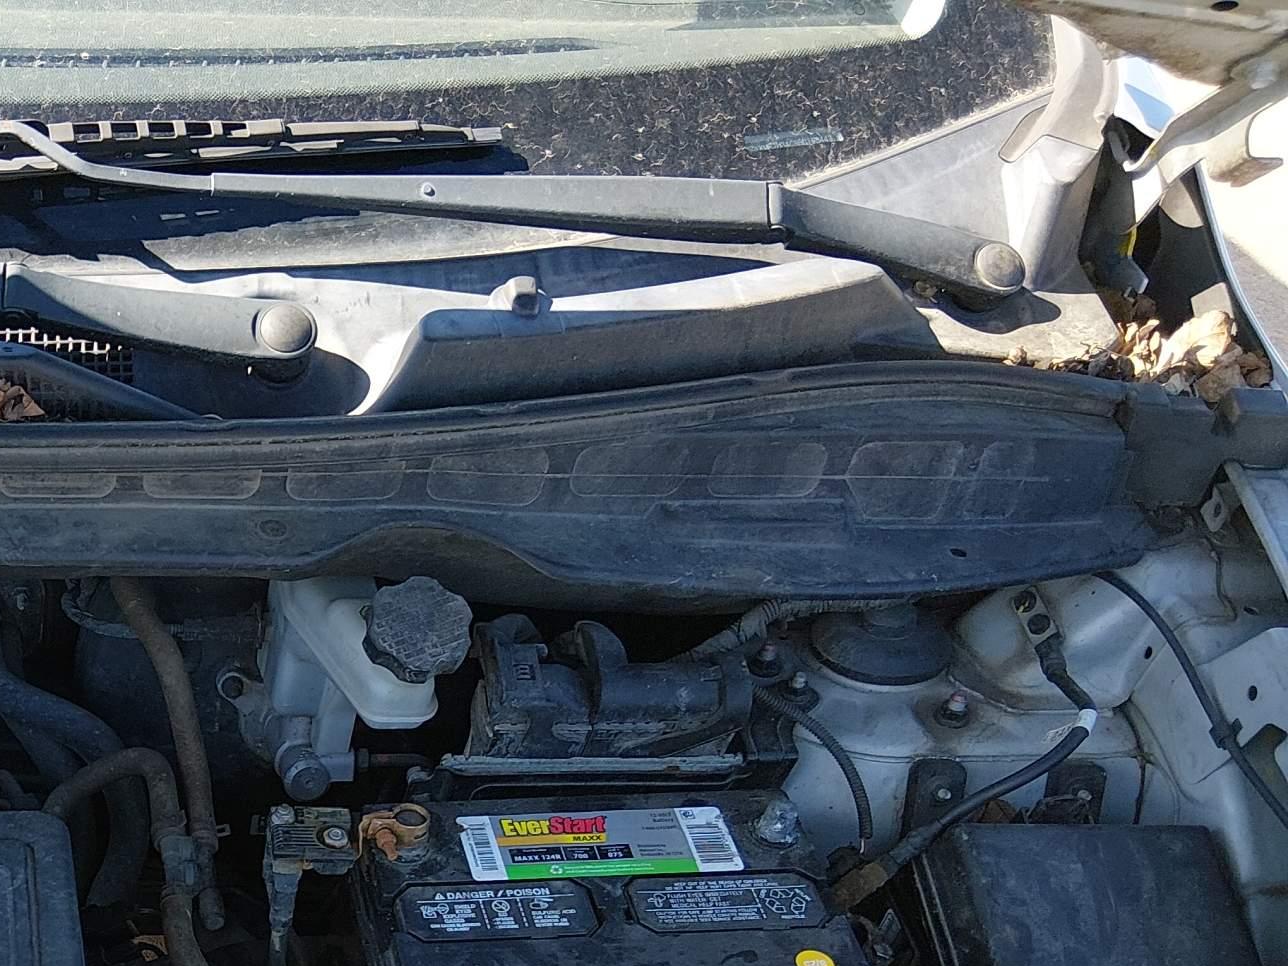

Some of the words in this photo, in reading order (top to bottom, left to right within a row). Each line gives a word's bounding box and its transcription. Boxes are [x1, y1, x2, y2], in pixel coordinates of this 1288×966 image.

[500, 815, 606, 837] EverStart
[514, 854, 541, 863] MAXX
[446, 890, 494, 900] DANGER
[506, 888, 550, 897] POISON
